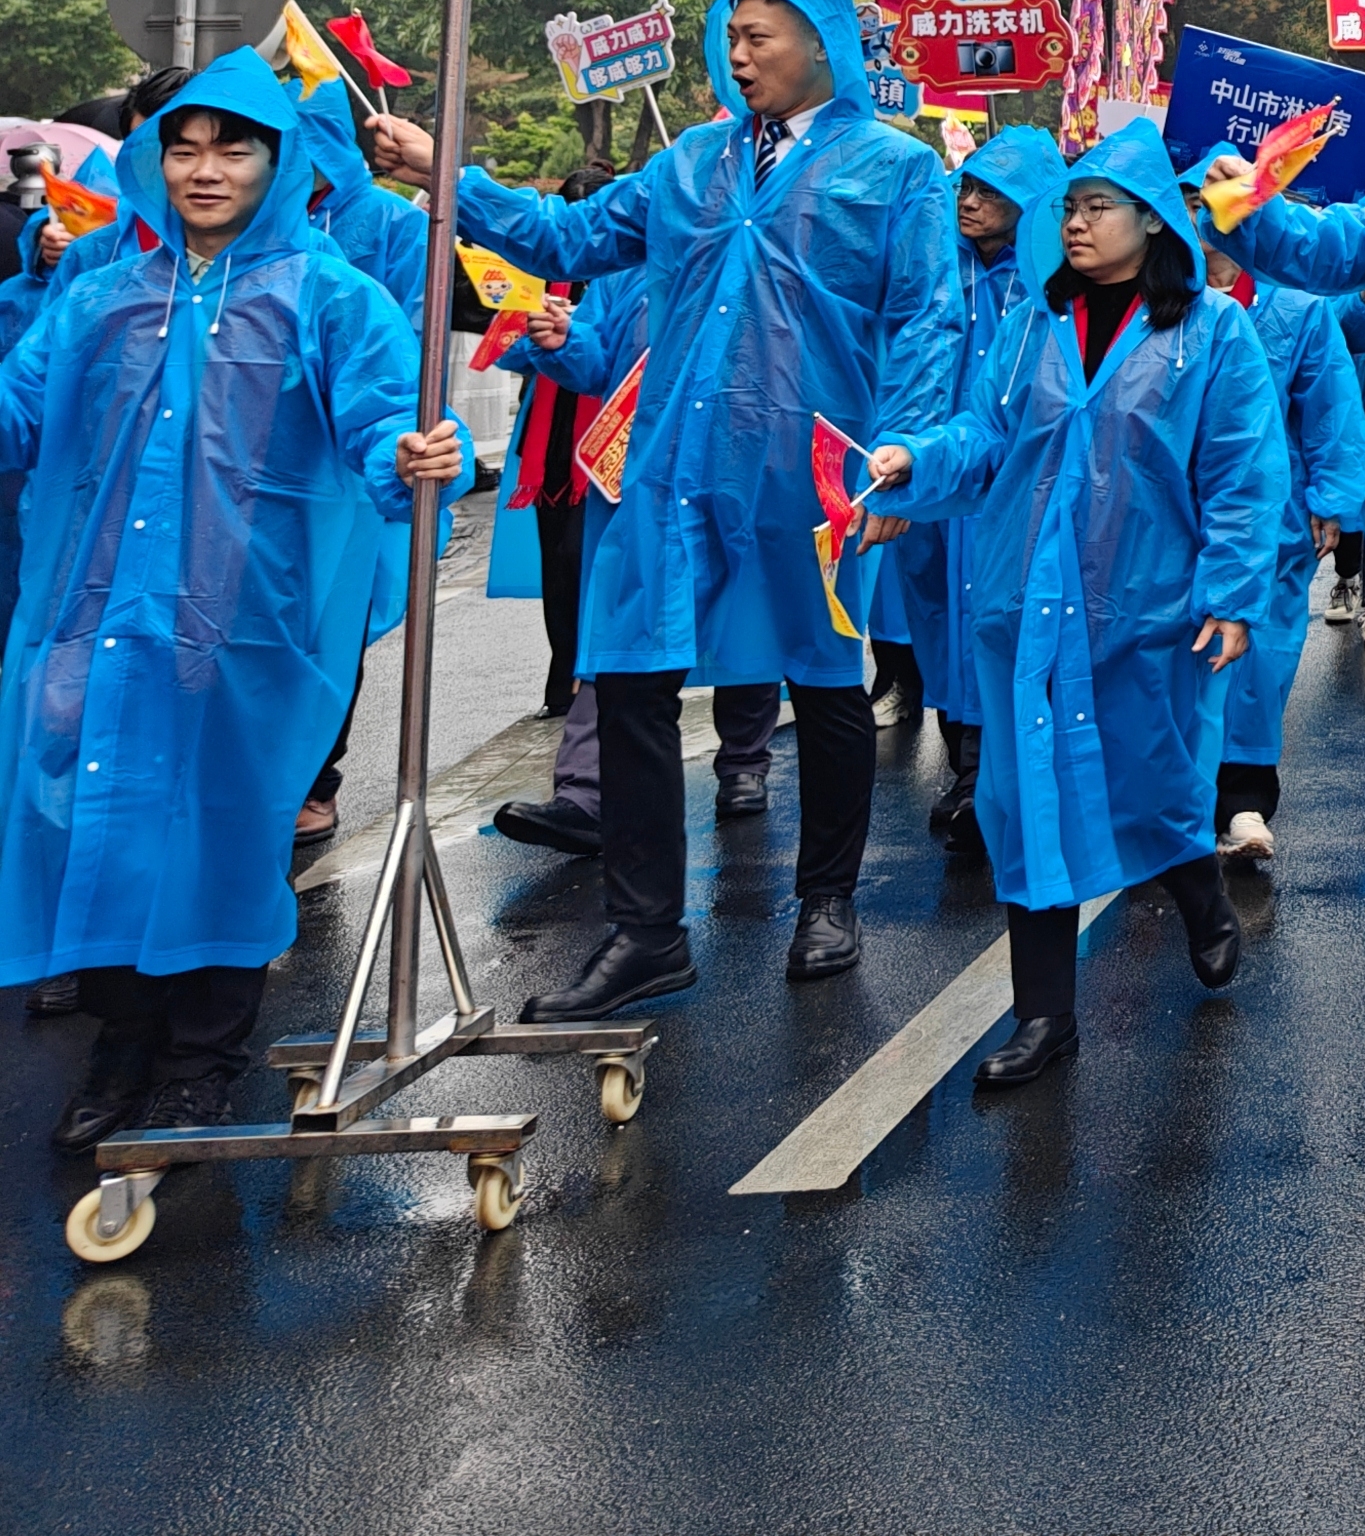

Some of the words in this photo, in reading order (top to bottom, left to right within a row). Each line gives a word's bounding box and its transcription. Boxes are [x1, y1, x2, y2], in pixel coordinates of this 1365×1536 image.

[590, 17, 664, 57] 威力威力
[911, 8, 1046, 37] 威力洗衣机
[588, 50, 663, 88] 够威够力
[1210, 77, 1352, 137] 中山市淋房
